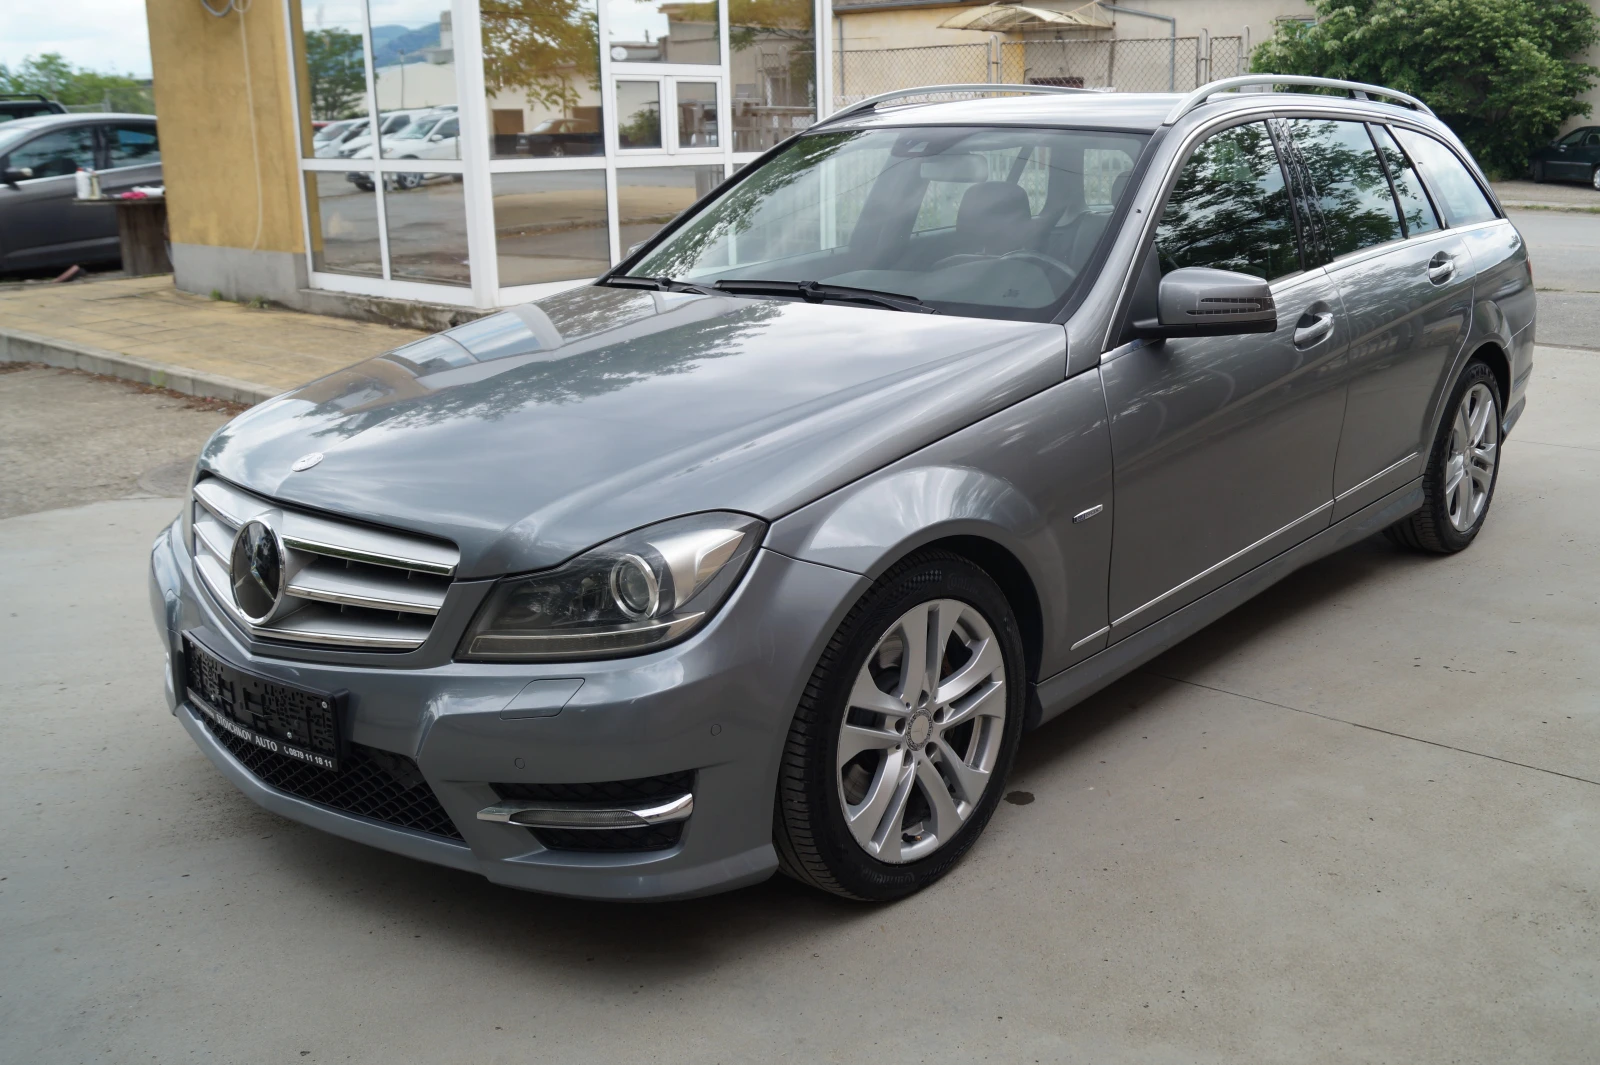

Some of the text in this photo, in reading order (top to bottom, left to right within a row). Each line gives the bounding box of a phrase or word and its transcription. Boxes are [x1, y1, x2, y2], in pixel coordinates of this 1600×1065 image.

[255, 735, 278, 752] AUTO
[288, 747, 304, 759] 0879
[305, 753, 313, 762] 11
[314, 756, 323, 765] 18
[324, 759, 332, 768] 11
